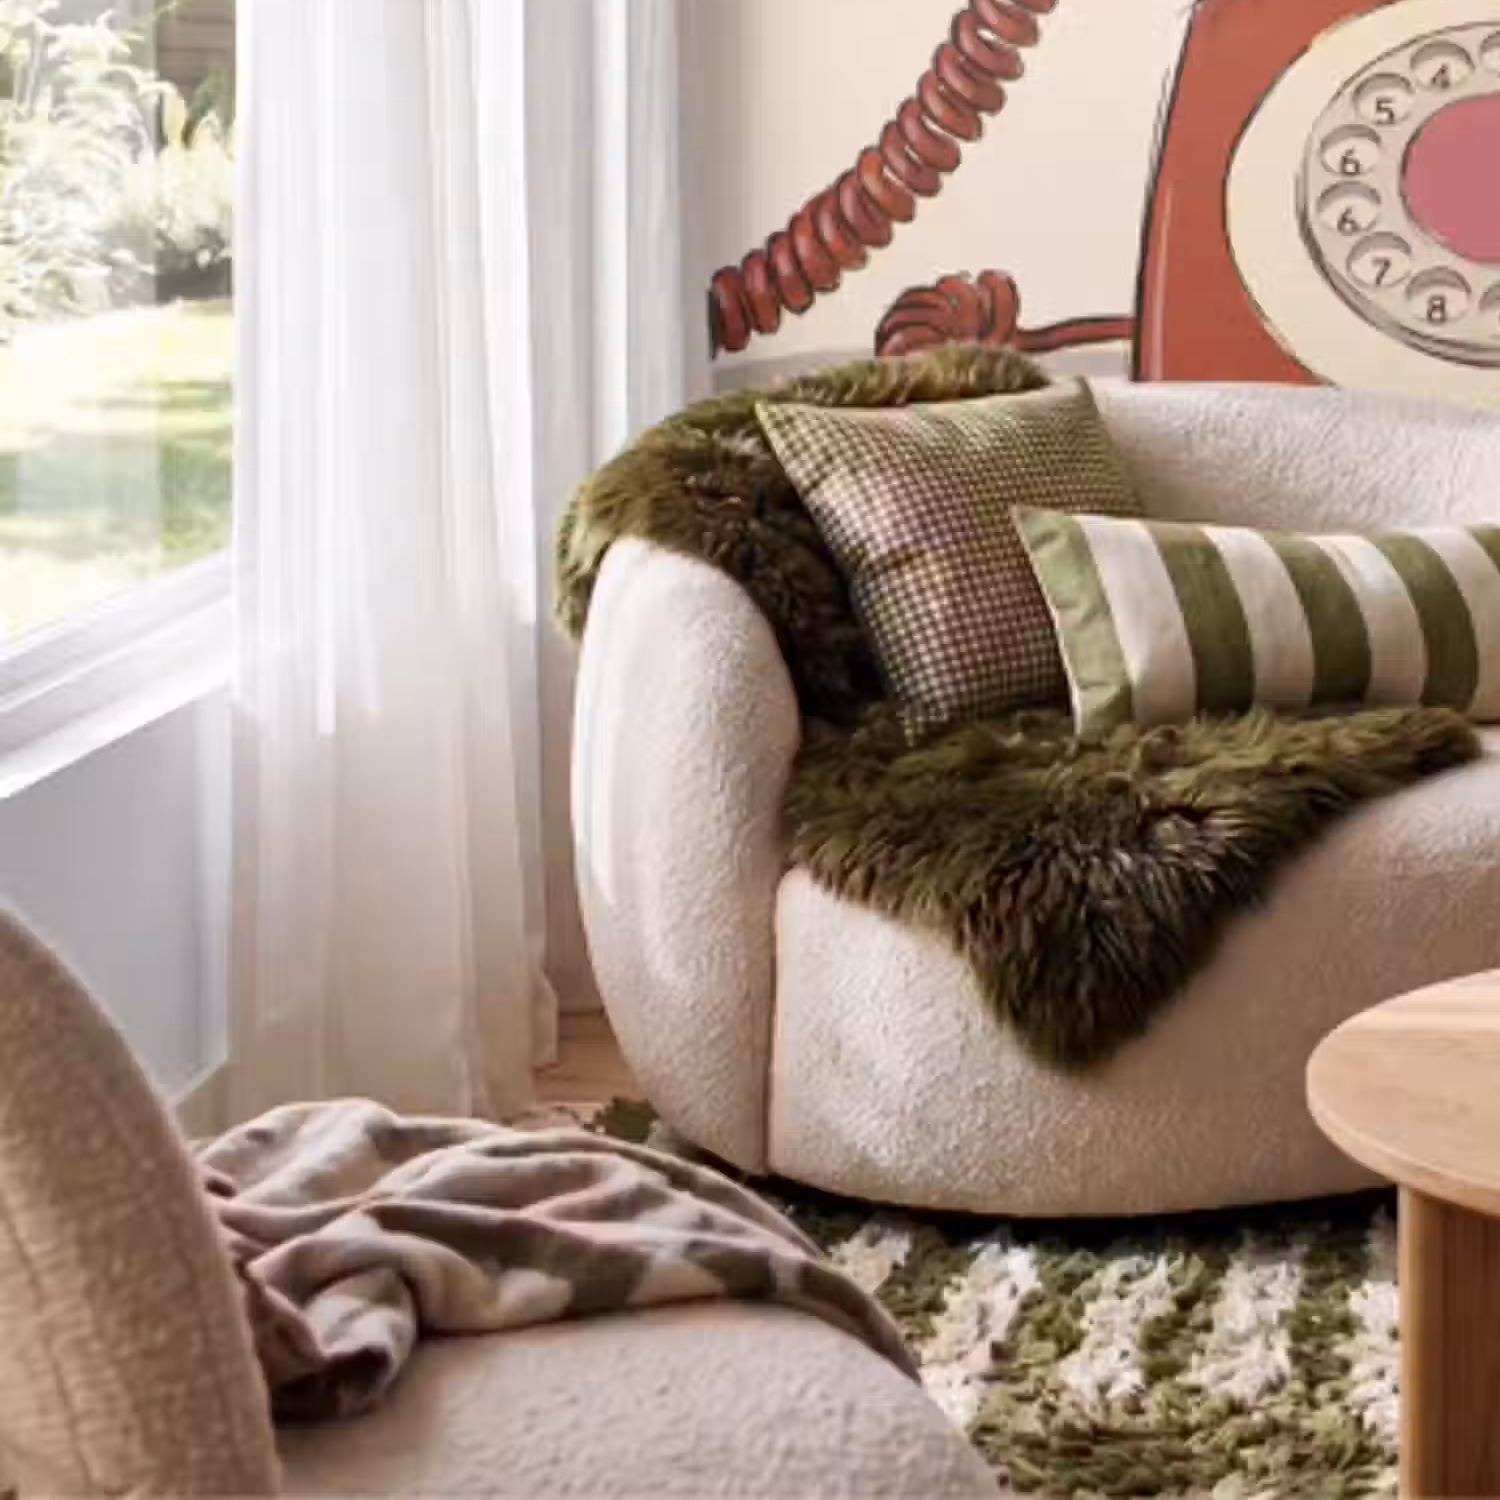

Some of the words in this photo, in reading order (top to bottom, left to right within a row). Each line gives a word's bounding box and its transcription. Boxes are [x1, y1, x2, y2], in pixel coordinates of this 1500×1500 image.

[1430, 63, 1451, 90] 4
[1375, 96, 1395, 125] 5
[1340, 146, 1361, 176] 6
[1337, 207, 1360, 236] 6
[1371, 256, 1391, 286] 7
[1426, 294, 1447, 325] 8
